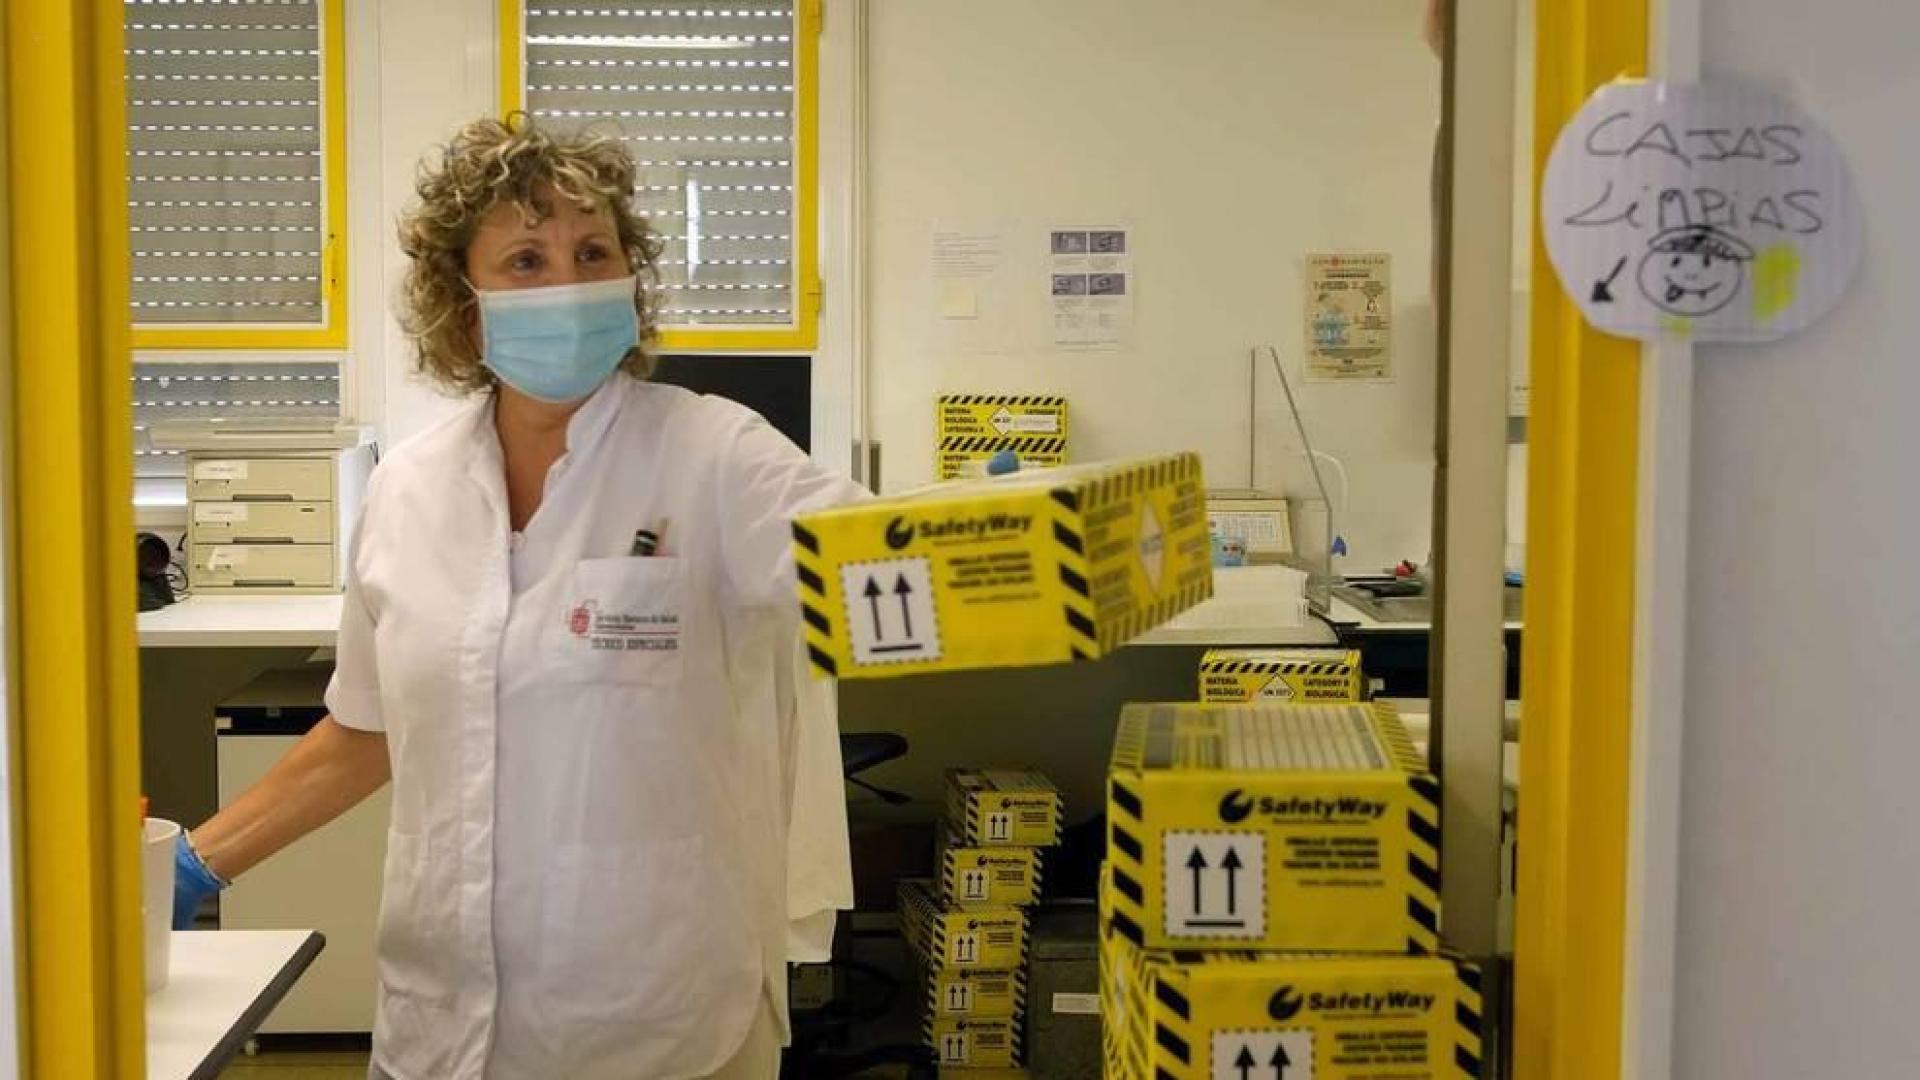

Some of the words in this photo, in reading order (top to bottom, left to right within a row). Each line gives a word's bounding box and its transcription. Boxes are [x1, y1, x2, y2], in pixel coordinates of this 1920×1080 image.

[1586, 112, 1803, 168] CAJAS
[919, 513, 1033, 539] SafetyWay
[1258, 795, 1387, 820] SafetyWay
[1308, 989, 1436, 1014] SafetyWay
